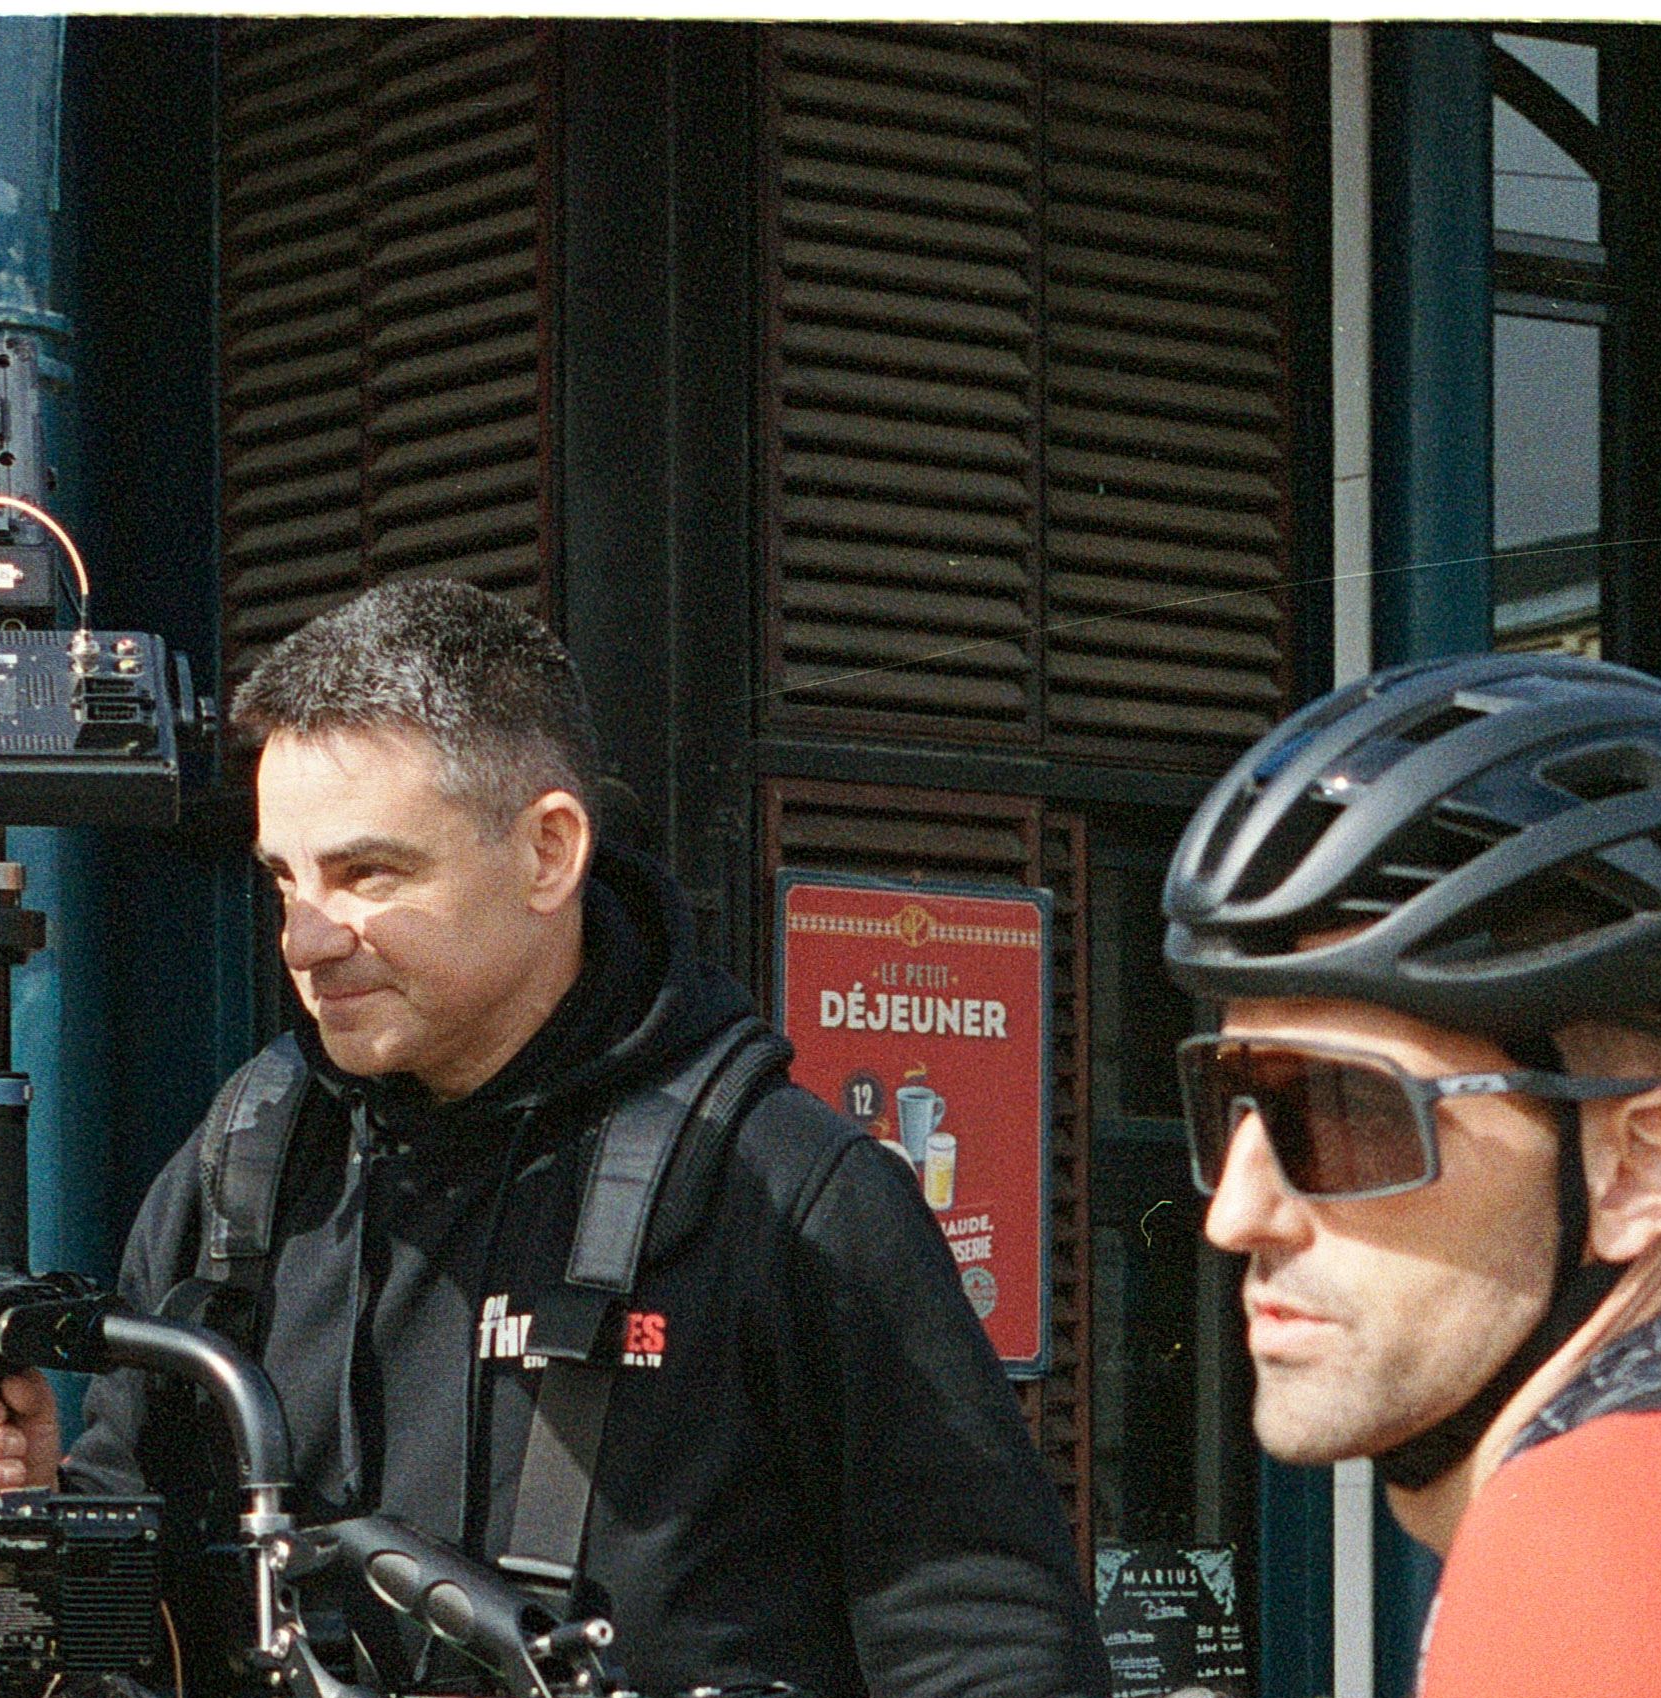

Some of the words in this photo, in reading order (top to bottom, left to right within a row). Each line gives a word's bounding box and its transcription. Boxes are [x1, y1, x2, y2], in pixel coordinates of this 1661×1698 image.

[881, 963, 898, 986] LE
[906, 964, 949, 989] PETIT
[819, 981, 1007, 1039] DÉJEUNER
[852, 1084, 873, 1116] 12
[625, 1313, 667, 1352] ES
[1121, 1568, 1198, 1585] MARIUS
